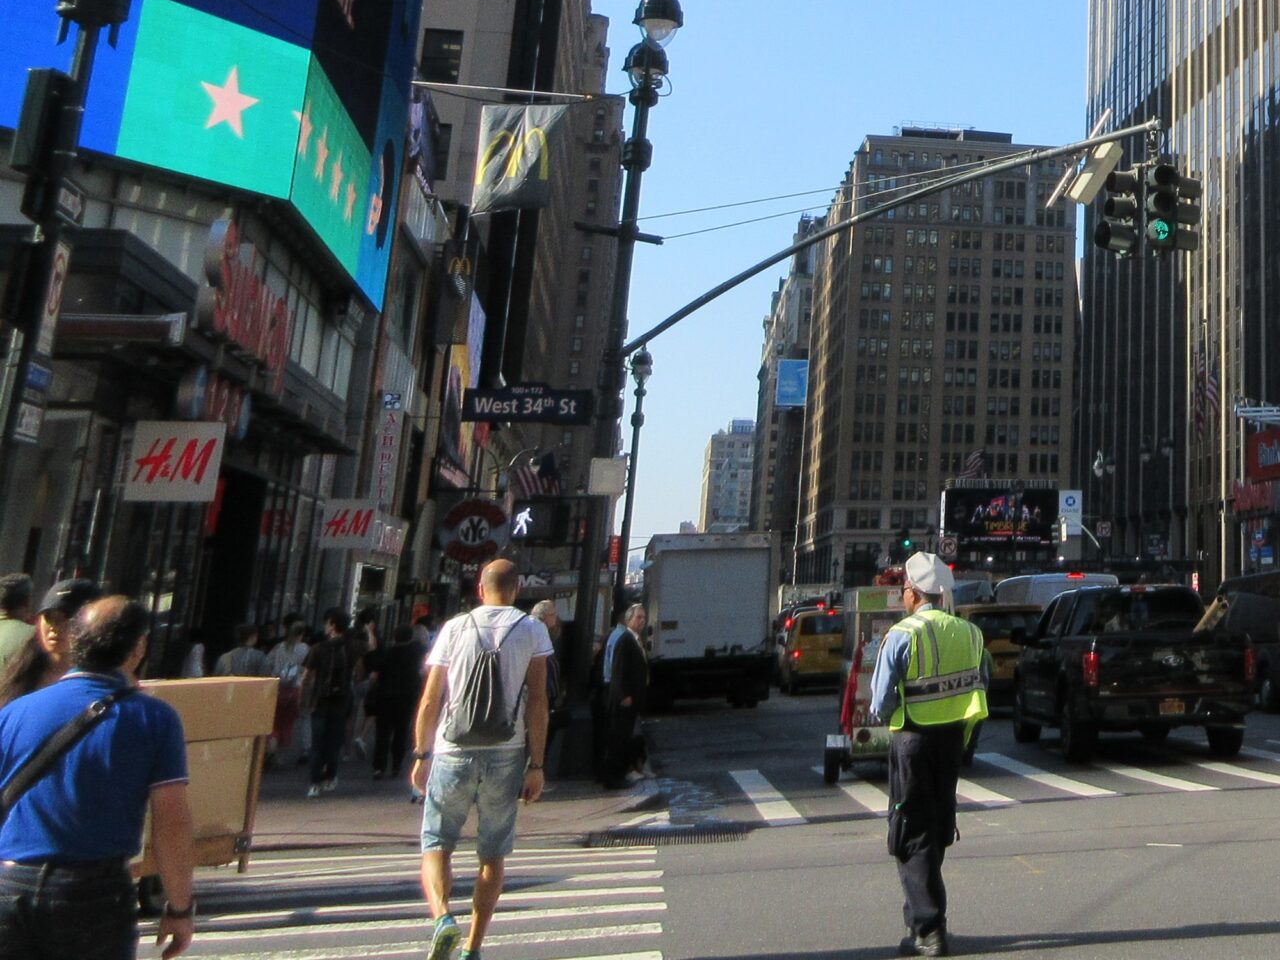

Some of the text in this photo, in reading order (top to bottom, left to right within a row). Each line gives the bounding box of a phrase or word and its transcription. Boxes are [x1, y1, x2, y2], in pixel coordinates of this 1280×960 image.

[475, 396, 577, 414] West 34th St
[132, 437, 217, 485] H&M
[324, 509, 374, 537] H&M
[461, 518, 488, 543] NYC
